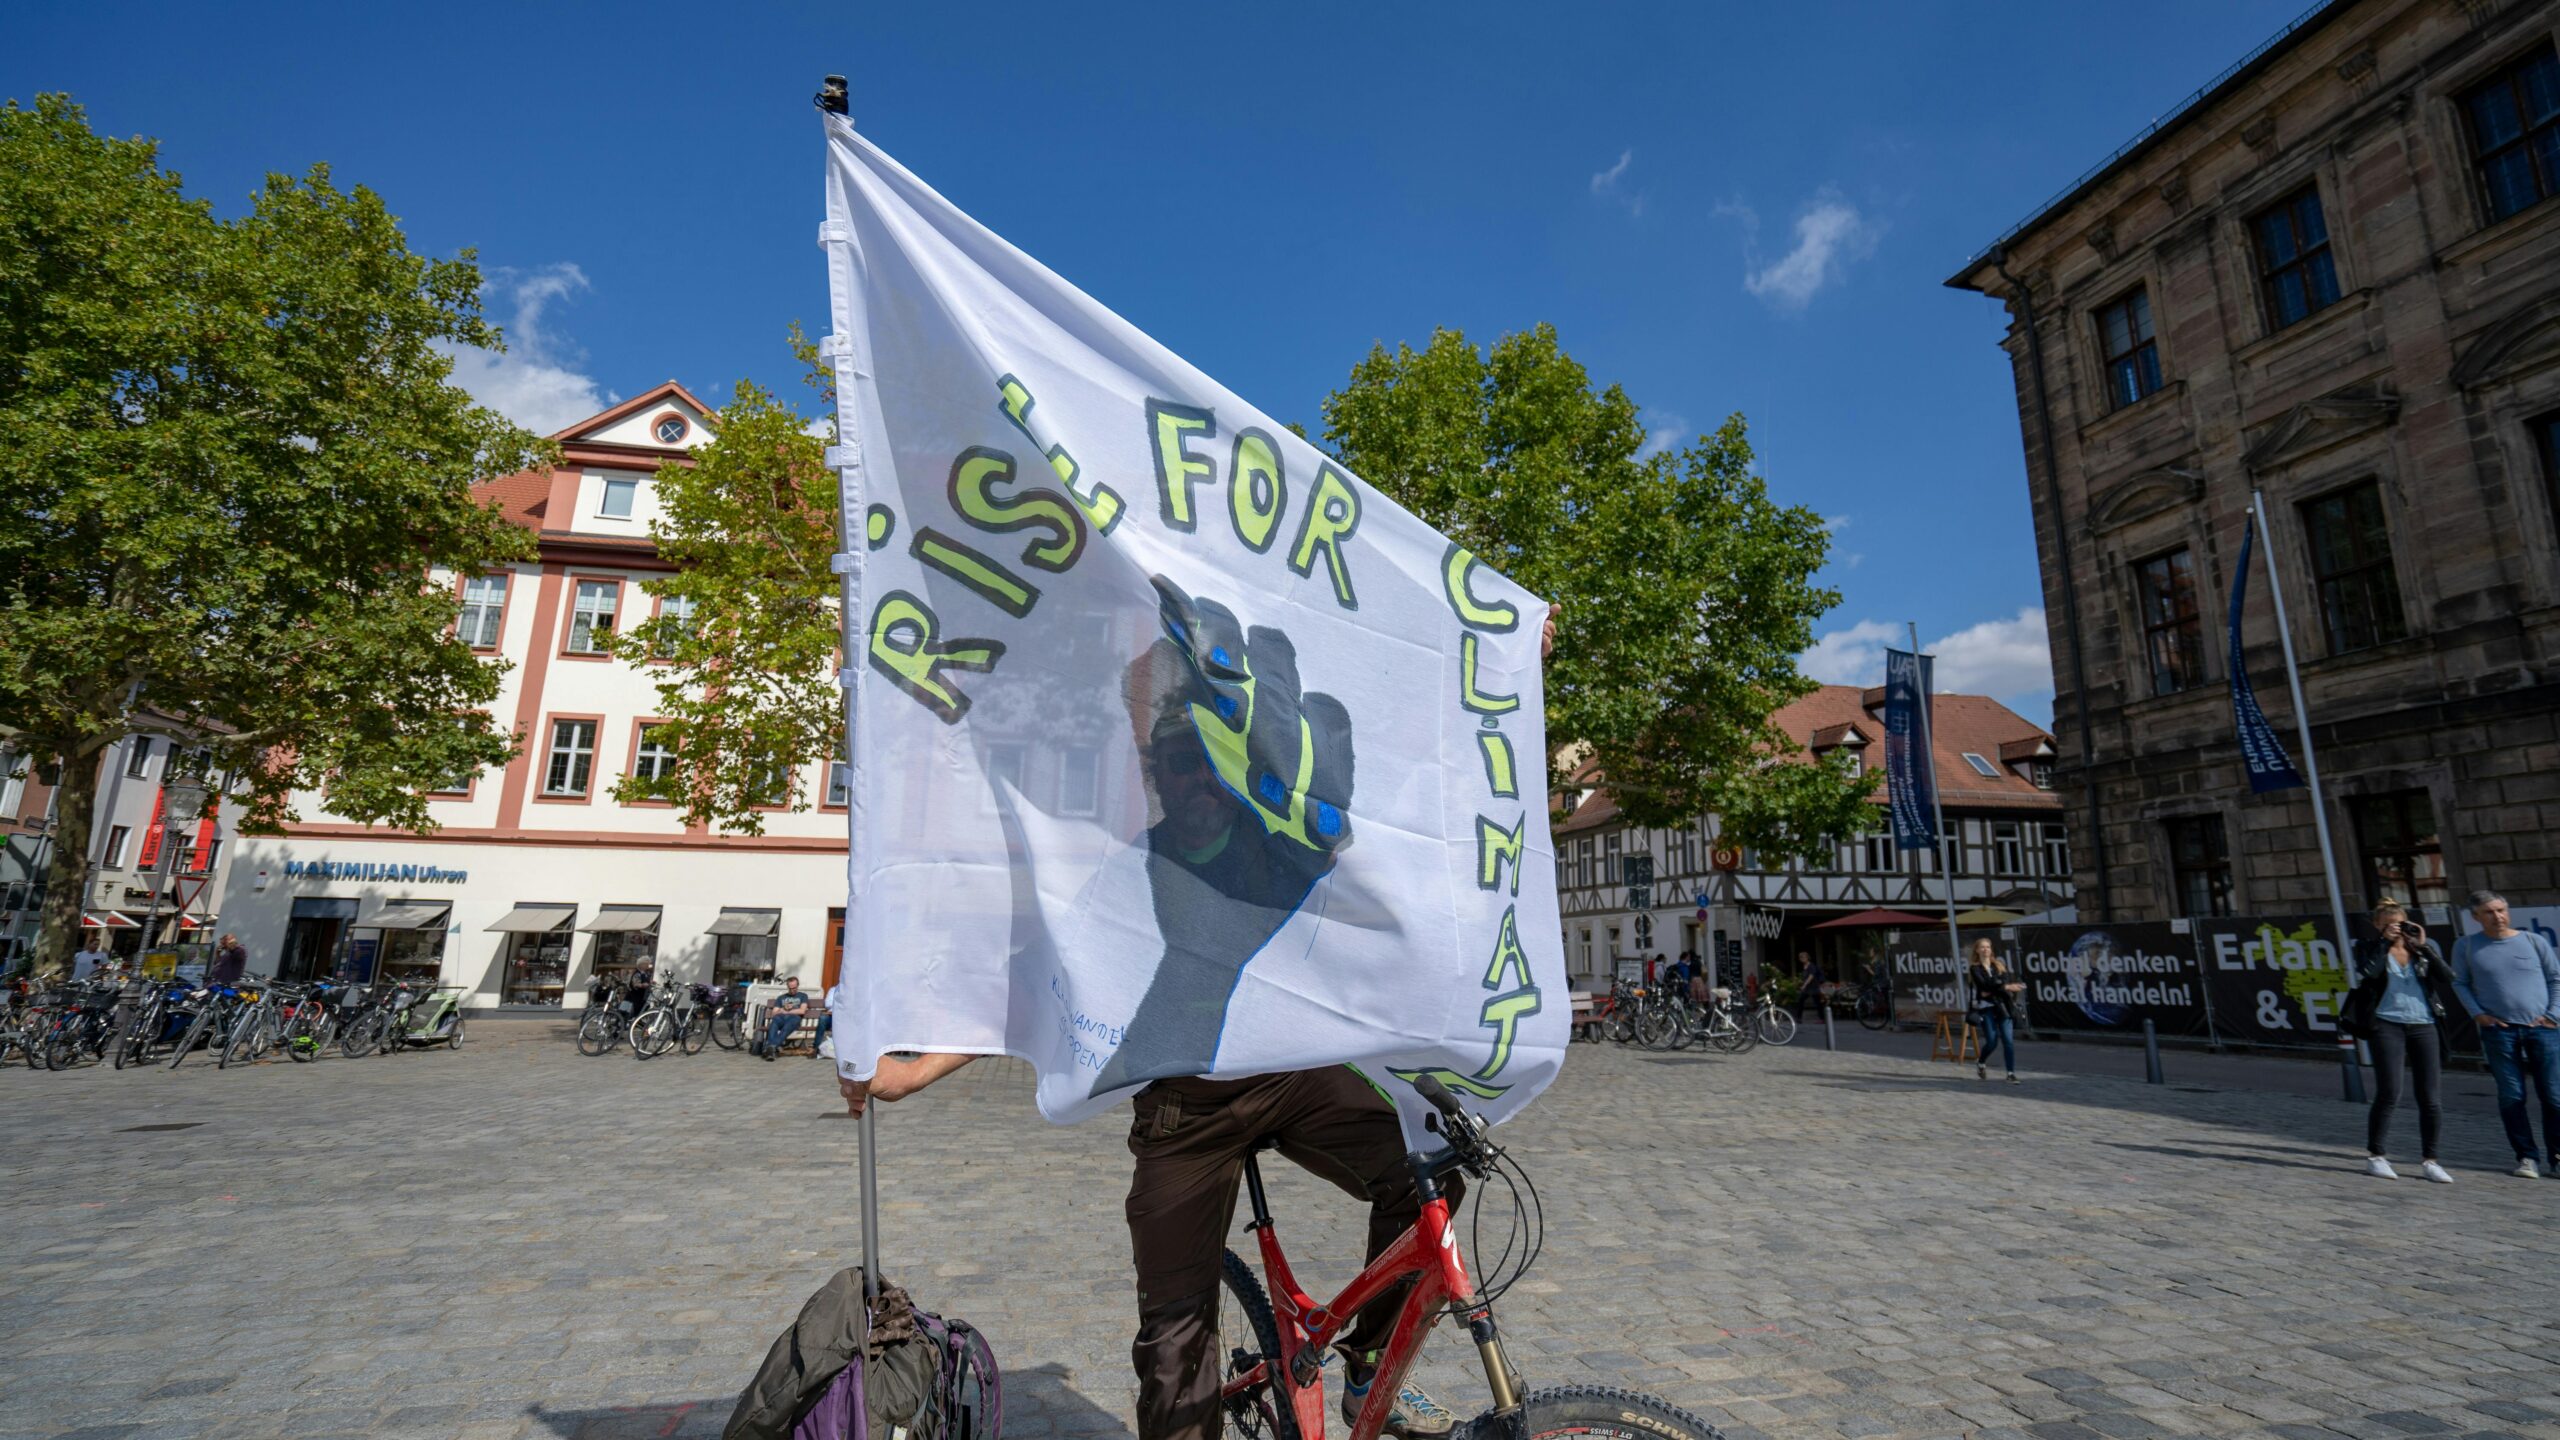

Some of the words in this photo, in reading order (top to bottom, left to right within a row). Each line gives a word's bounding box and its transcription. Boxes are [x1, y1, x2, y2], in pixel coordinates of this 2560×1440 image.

[869, 372, 1127, 726] RISE
[1145, 395, 1362, 611] FOR
[284, 861, 417, 881] MAXIMILIAN
[418, 866, 467, 883] Uhren
[2025, 950, 2092, 974] Global
[2096, 949, 2180, 974] denken
[2036, 980, 2088, 1003] lokal
[2091, 980, 2193, 1007] handeln!
[2256, 989, 2294, 1030] &
